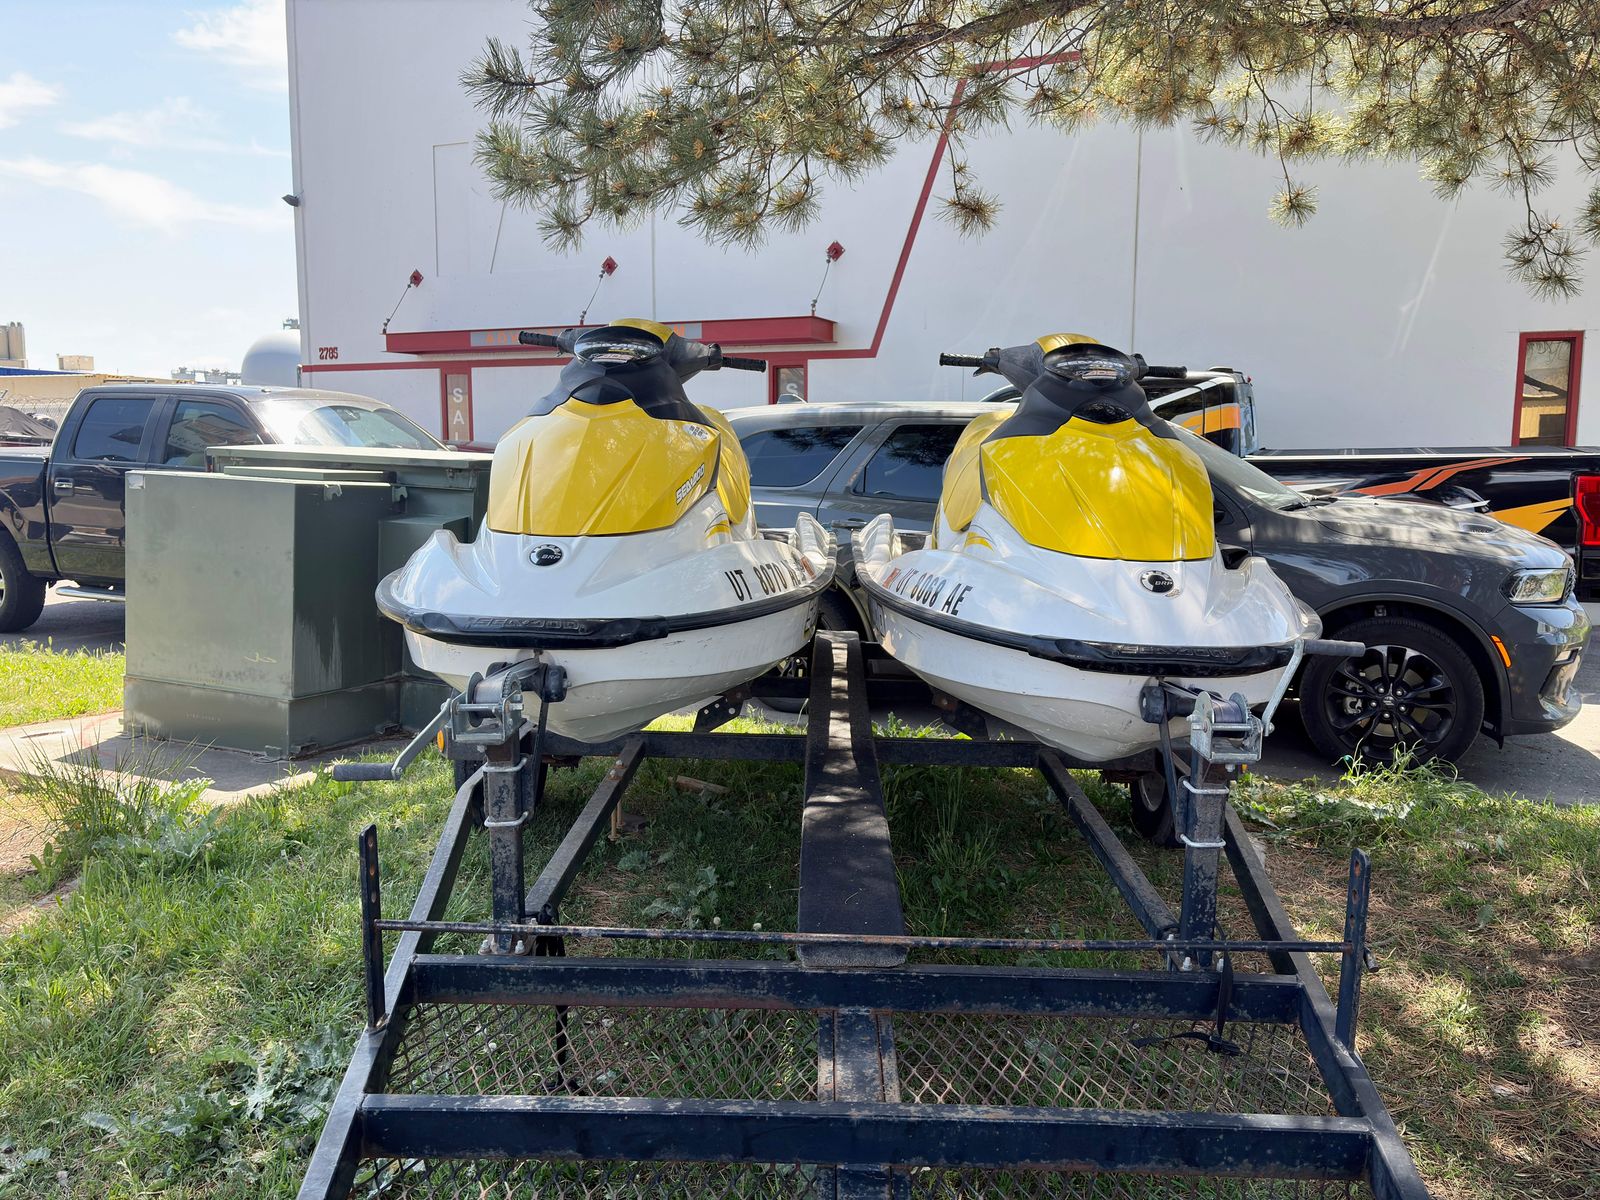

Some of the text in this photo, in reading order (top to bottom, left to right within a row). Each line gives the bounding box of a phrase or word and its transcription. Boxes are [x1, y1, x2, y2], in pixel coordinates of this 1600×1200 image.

[319, 346, 339, 360] 2785
[724, 569, 753, 601] UT
[753, 562, 787, 596] 8070
[896, 567, 919, 595] UT
[941, 583, 974, 616] AE
